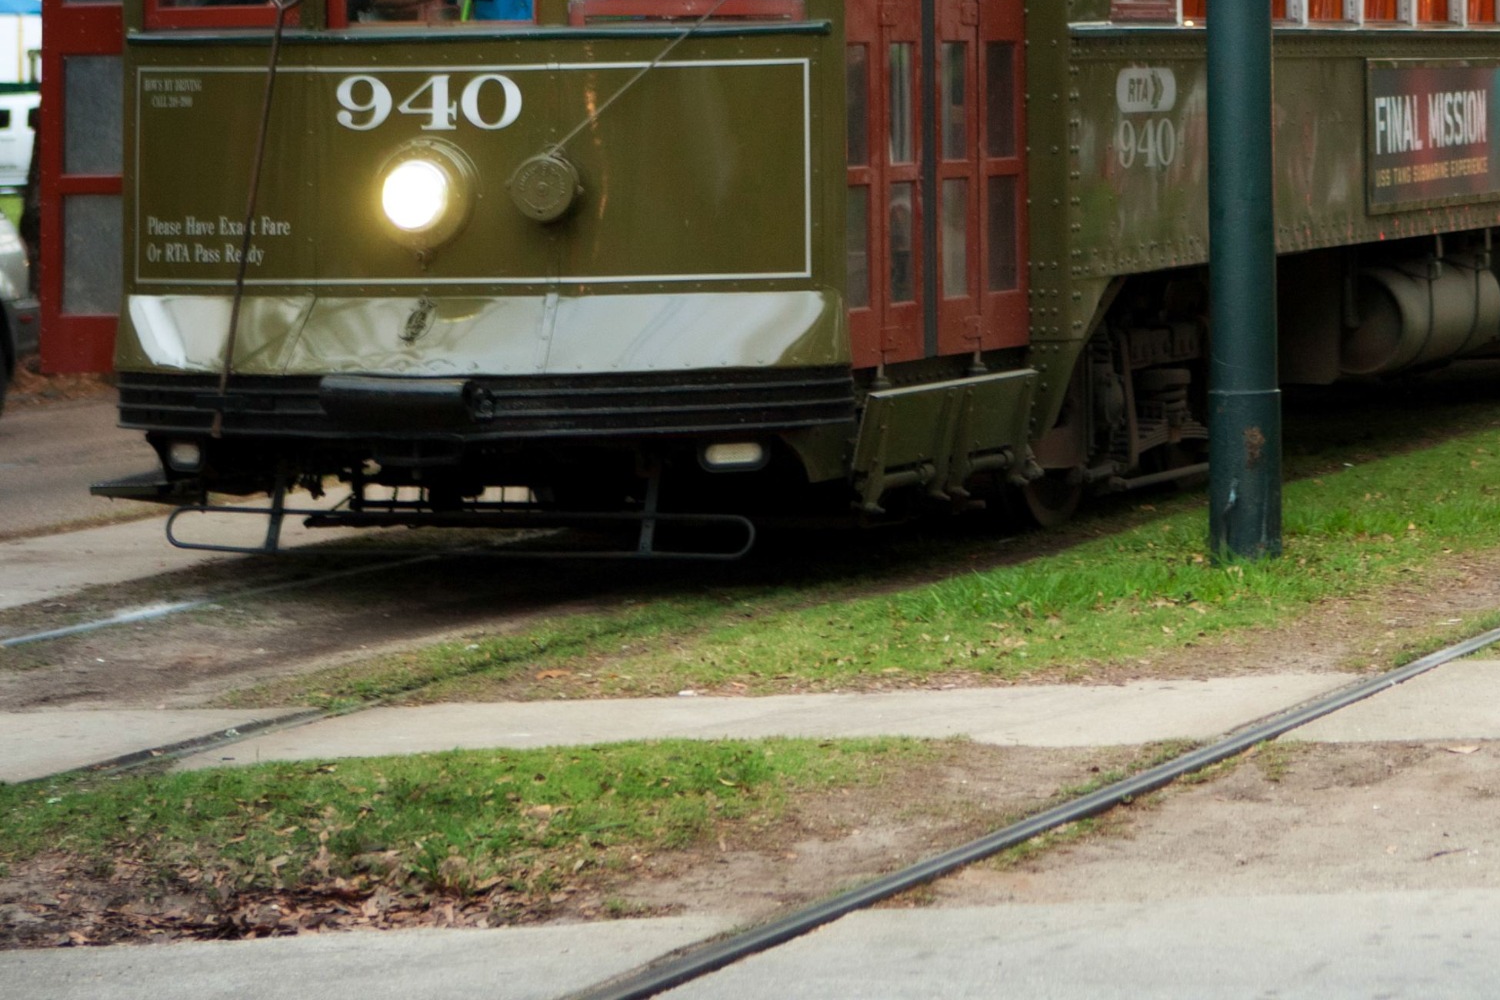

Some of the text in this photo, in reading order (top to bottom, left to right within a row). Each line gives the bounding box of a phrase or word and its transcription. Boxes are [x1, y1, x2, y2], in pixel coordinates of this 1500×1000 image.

[1127, 78, 1149, 102] RTA
[336, 74, 523, 131] 940
[1374, 89, 1487, 154] FINAL MISSION
[1119, 118, 1175, 168] 940
[1376, 168, 1391, 187] USS
[147, 216, 291, 235] Please Have Exat Fare
[146, 243, 265, 266] Or RTA Pass Redy
